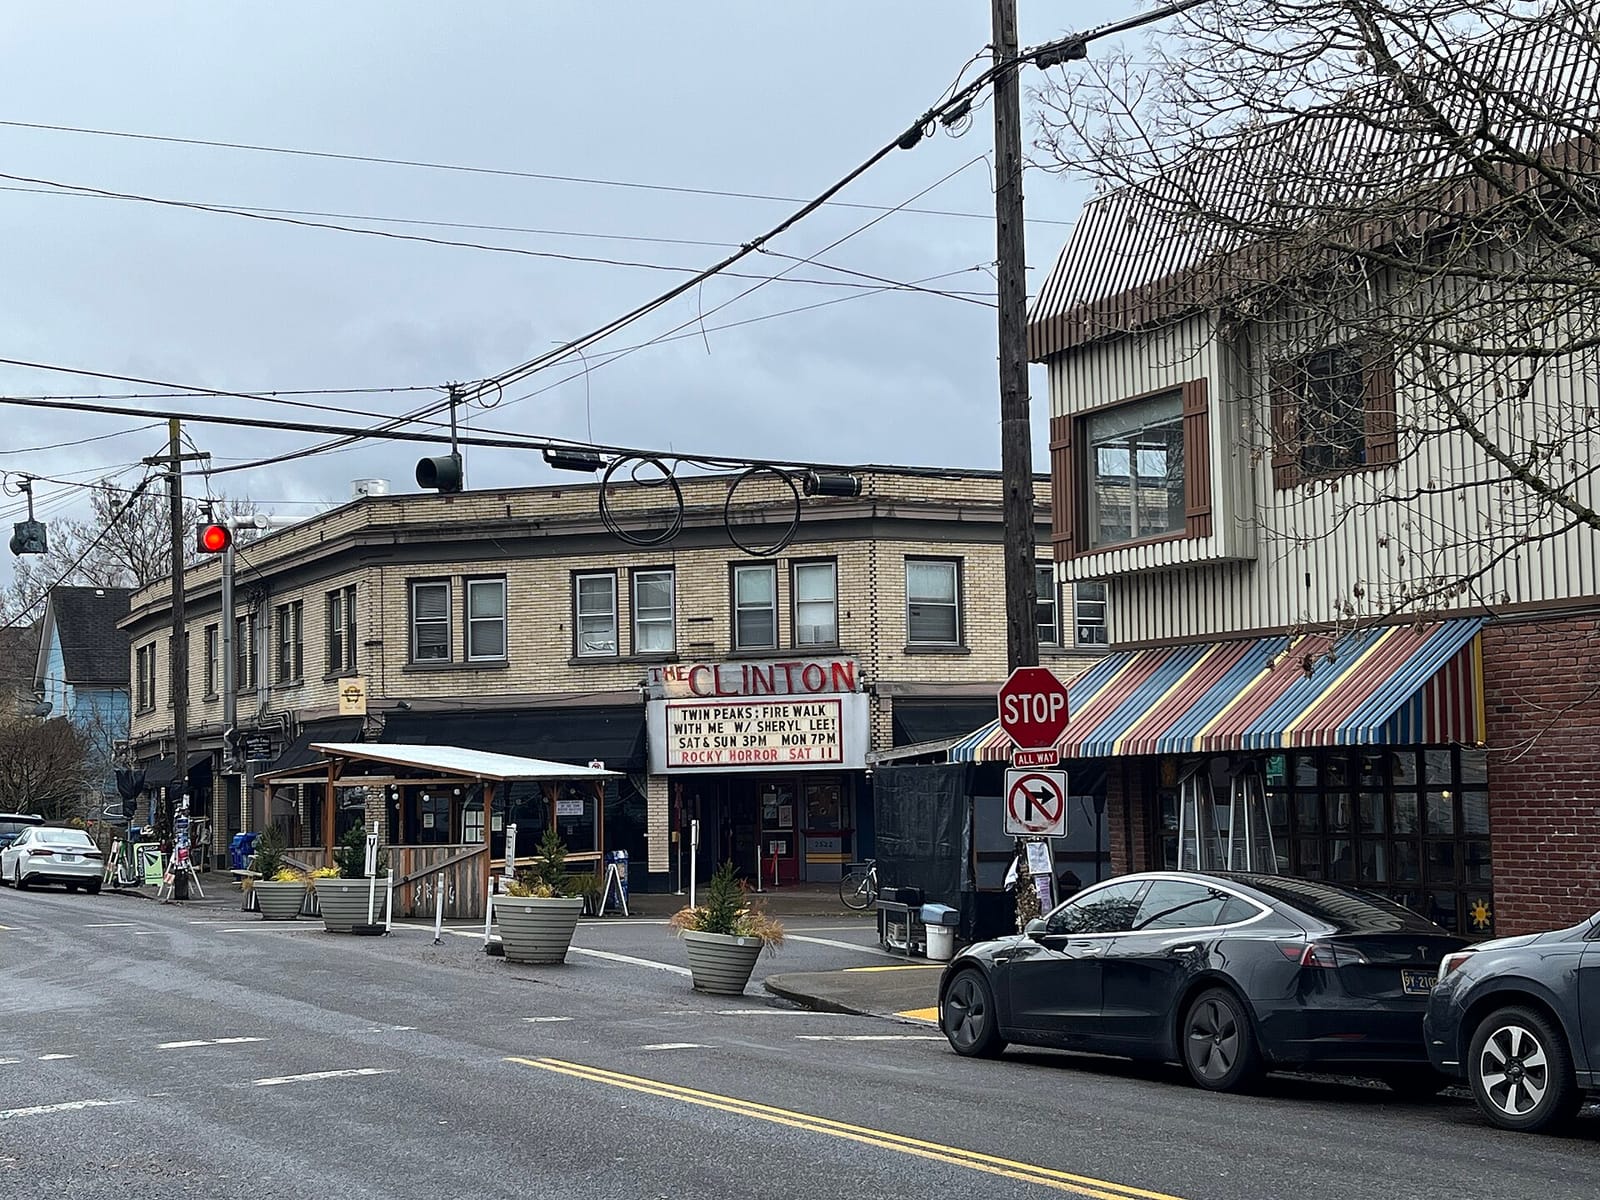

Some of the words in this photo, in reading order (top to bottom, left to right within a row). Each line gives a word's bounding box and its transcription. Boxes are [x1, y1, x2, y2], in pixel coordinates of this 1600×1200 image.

[648, 666, 688, 682] THE
[688, 661, 856, 696] CLINTON
[681, 708, 710, 721] TWIN
[763, 706, 789, 718] FIRE
[793, 704, 826, 717] WALK
[1004, 692, 1065, 725] STOP
[674, 723, 702, 735] WITH
[708, 722, 724, 734] ME
[734, 721, 750, 733] W/
[757, 719, 801, 732] SHERYL
[810, 718, 836, 730] LEE!
[714, 735, 737, 747] SUN
[742, 735, 767, 747] 3PM
[781, 733, 807, 746] MON
[811, 732, 836, 745] 7PM
[682, 750, 722, 763] ROCKY
[729, 749, 778, 761] HORROR
[789, 748, 811, 761] SAT
[1018, 754, 1034, 765] ALL
[1036, 752, 1055, 763] WAY
